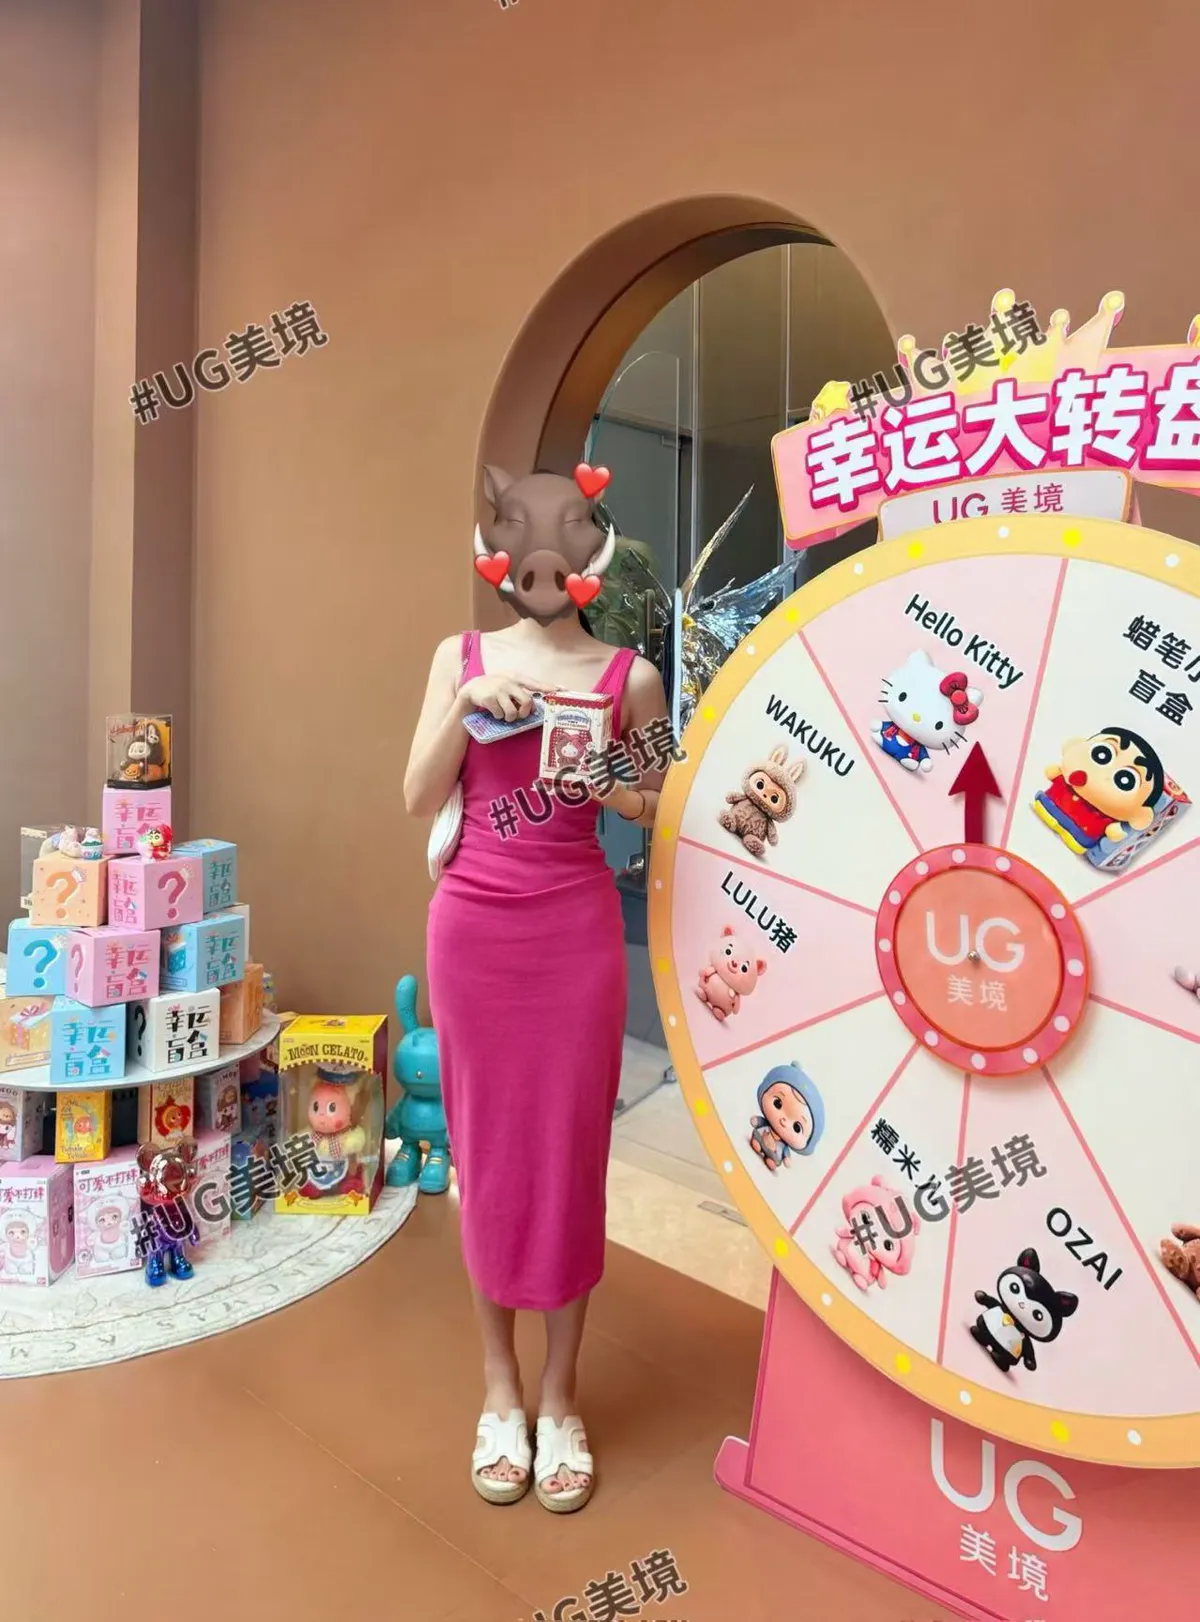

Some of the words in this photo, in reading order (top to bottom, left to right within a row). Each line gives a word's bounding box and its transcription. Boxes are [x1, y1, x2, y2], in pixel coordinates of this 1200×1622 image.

[805, 358, 1200, 512] 幸运大转盘
[932, 492, 989, 524] UG
[1001, 482, 1064, 514] 美境
[904, 593, 963, 648] Hello
[964, 634, 1025, 690] Kitty
[765, 693, 856, 777] WAKUKU
[1128, 668, 1194, 726] 盲盒
[720, 871, 798, 955] LULU猪
[926, 911, 1025, 973] UG
[948, 975, 1007, 1012] 美境
[322, 1043, 365, 1062] GELATO
[1046, 1207, 1123, 1291] OZAI
[930, 1418, 1083, 1552] UG
[960, 1523, 1048, 1602] 美境
